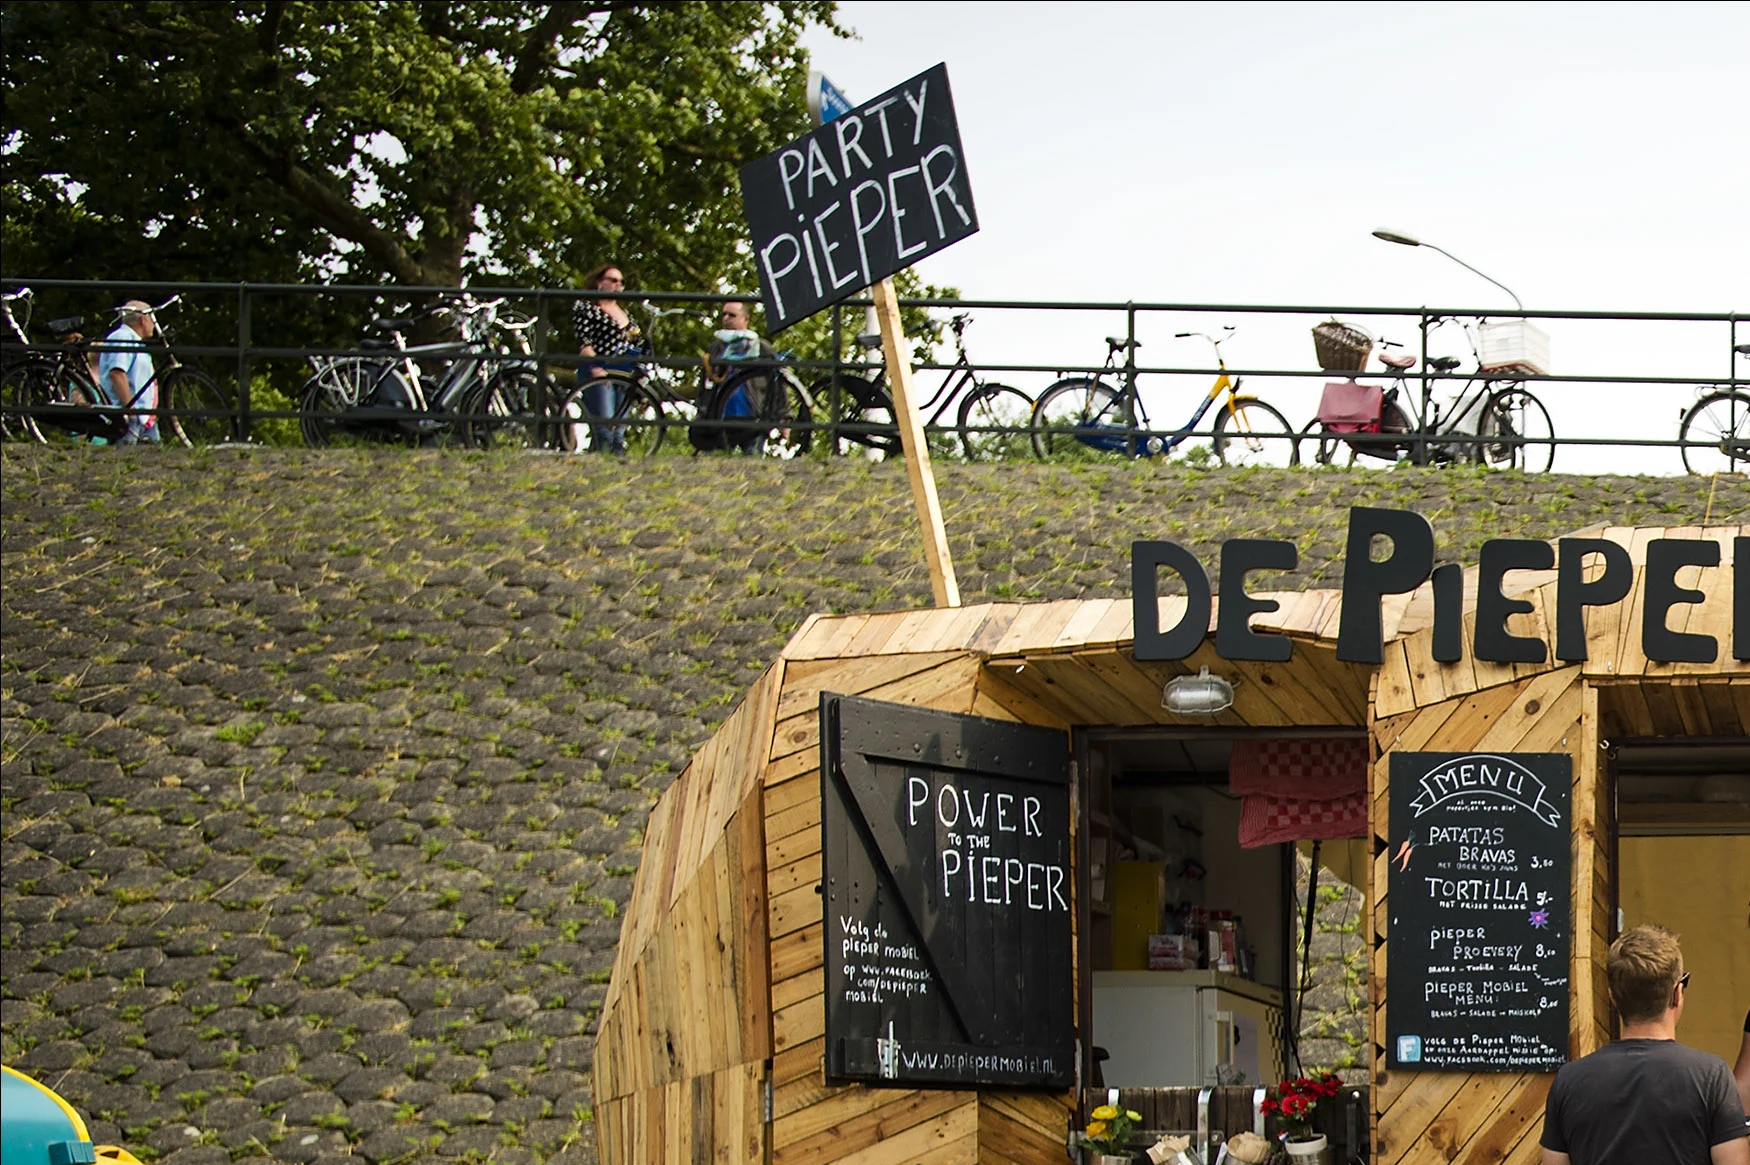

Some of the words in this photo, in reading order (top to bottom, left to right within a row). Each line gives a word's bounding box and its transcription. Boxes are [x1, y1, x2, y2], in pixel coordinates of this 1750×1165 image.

[779, 79, 928, 211] PARTY
[1130, 538, 1298, 663] DE
[1433, 764, 1523, 795] MENU
[908, 776, 1043, 838] POWER
[948, 832, 962, 846] TO
[966, 834, 990, 850] THE
[1429, 826, 1504, 845] PATATAS
[1460, 846, 1516, 864] BRAVAS
[1439, 900, 1455, 908] MET
[840, 915, 869, 942] Volg
[1453, 944, 1523, 962] PROEVERY
